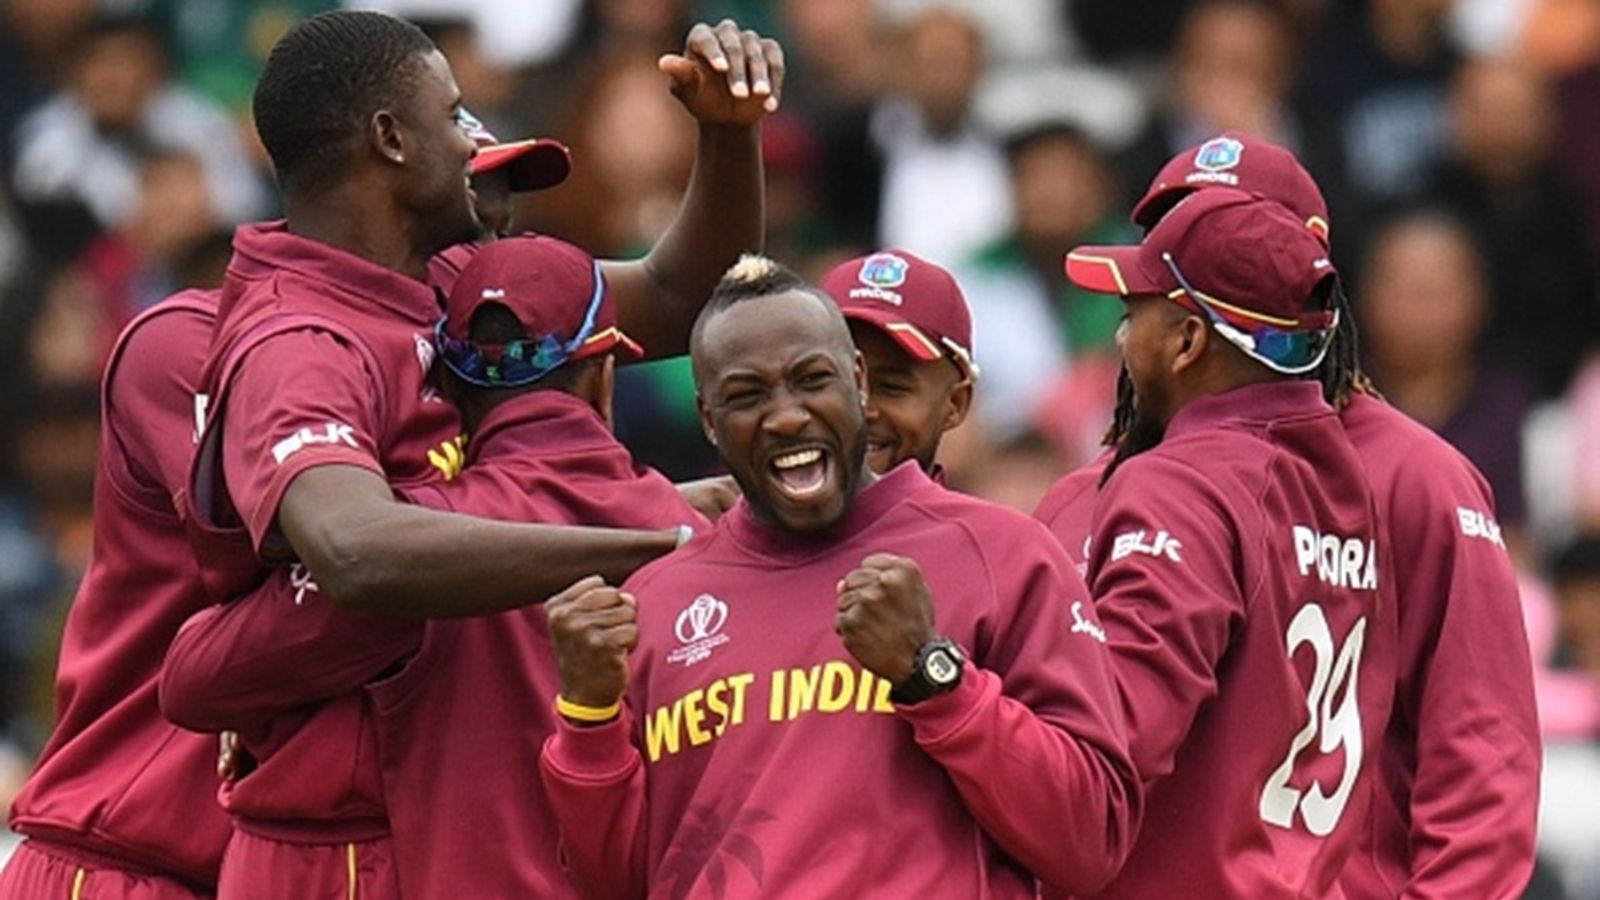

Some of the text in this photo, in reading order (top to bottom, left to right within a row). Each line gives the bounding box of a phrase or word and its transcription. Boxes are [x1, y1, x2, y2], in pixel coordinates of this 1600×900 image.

[1111, 529, 1182, 562] BLK
[645, 673, 755, 762] WEST
[1259, 603, 1367, 836] 29
